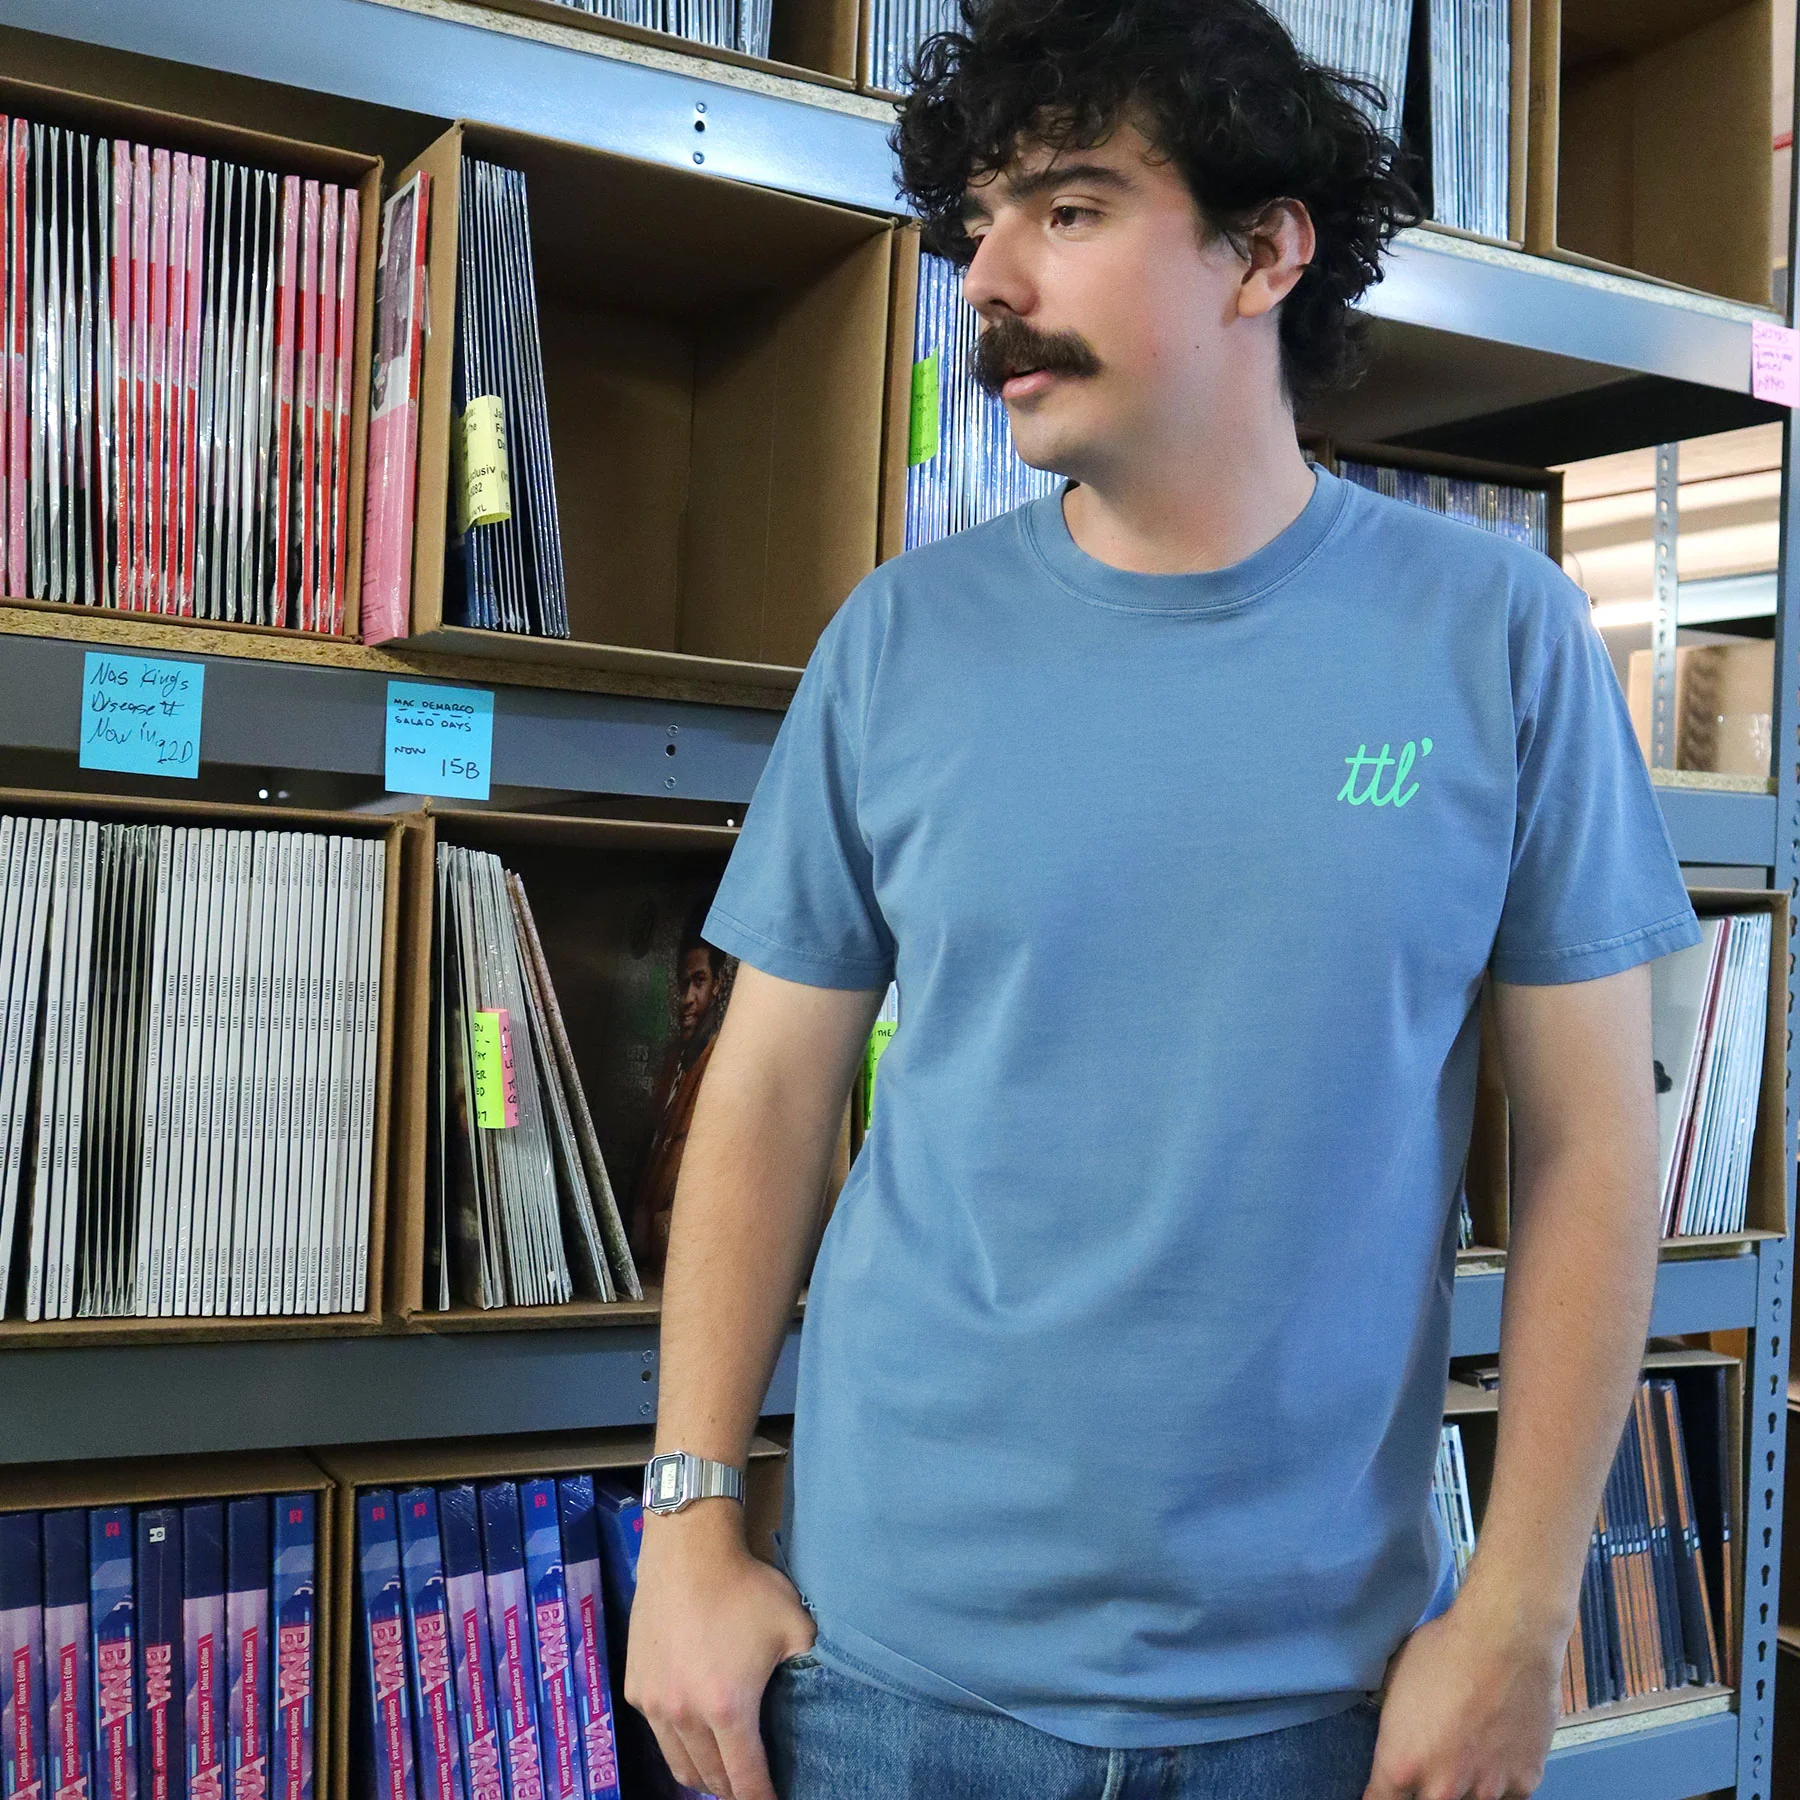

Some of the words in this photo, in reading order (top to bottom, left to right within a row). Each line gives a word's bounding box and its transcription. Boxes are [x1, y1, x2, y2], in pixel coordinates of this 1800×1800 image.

[90, 662, 128, 685] Nas
[92, 691, 155, 716] Disease
[394, 698, 415, 707] MAC
[422, 701, 474, 714] DEMARCO
[87, 717, 132, 744] Now
[395, 716, 434, 726] SALAD
[441, 721, 471, 732] DAYS
[442, 759, 480, 779] 15B
[877, 1029, 892, 1037] THE
[507, 1617, 517, 1640] Edition
[582, 1605, 592, 1628] Edition
[467, 1621, 476, 1643] Edition
[585, 1626, 594, 1648] Deluxe
[200, 1646, 210, 1668] Edition
[244, 1640, 254, 1662] Edition
[469, 1641, 478, 1662] Deluxe
[510, 1638, 519, 1660] Deluxe
[16, 1660, 26, 1682] Edition
[63, 1657, 73, 1679] Edition
[200, 1669, 210, 1691] Deluxe
[244, 1662, 254, 1684] Deluxe
[587, 1656, 597, 1688] Soundtrack
[17, 1683, 26, 1705] Deluxe
[64, 1680, 73, 1702] Deluxe
[471, 1671, 482, 1705] Soundtrack
[512, 1668, 522, 1701] Soundtrack
[553, 1678, 563, 1707] Complete
[244, 1693, 254, 1728] Soundtrack
[389, 1698, 399, 1728] Complete
[434, 1692, 443, 1721] Complete
[514, 1699, 524, 1729] Complete
[590, 1686, 600, 1715] Complete
[64, 1711, 74, 1748] Soundtrack
[200, 1699, 210, 1736] Soundtrack
[290, 1706, 300, 1738] Complete
[473, 1703, 484, 1733] Complete
[555, 1704, 565, 1738] Soundtrack
[18, 1714, 28, 1751] Soundtrack
[113, 1725, 122, 1756] Complete
[244, 1728, 254, 1758] Complete
[390, 1726, 400, 1761] Soundtrack
[435, 1719, 446, 1754] Soundtrack
[65, 1748, 75, 1778] Complete
[201, 1735, 211, 1766] Complete
[290, 1736, 300, 1771] Soundtrack
[559, 1745, 569, 1767] Deluxe
[19, 1751, 29, 1782] Complete
[114, 1754, 124, 1792] Soundtrack
[393, 1769, 402, 1790] Deluxe
[440, 1762, 449, 1783] Deluxe
[562, 1765, 570, 1787] Edition
